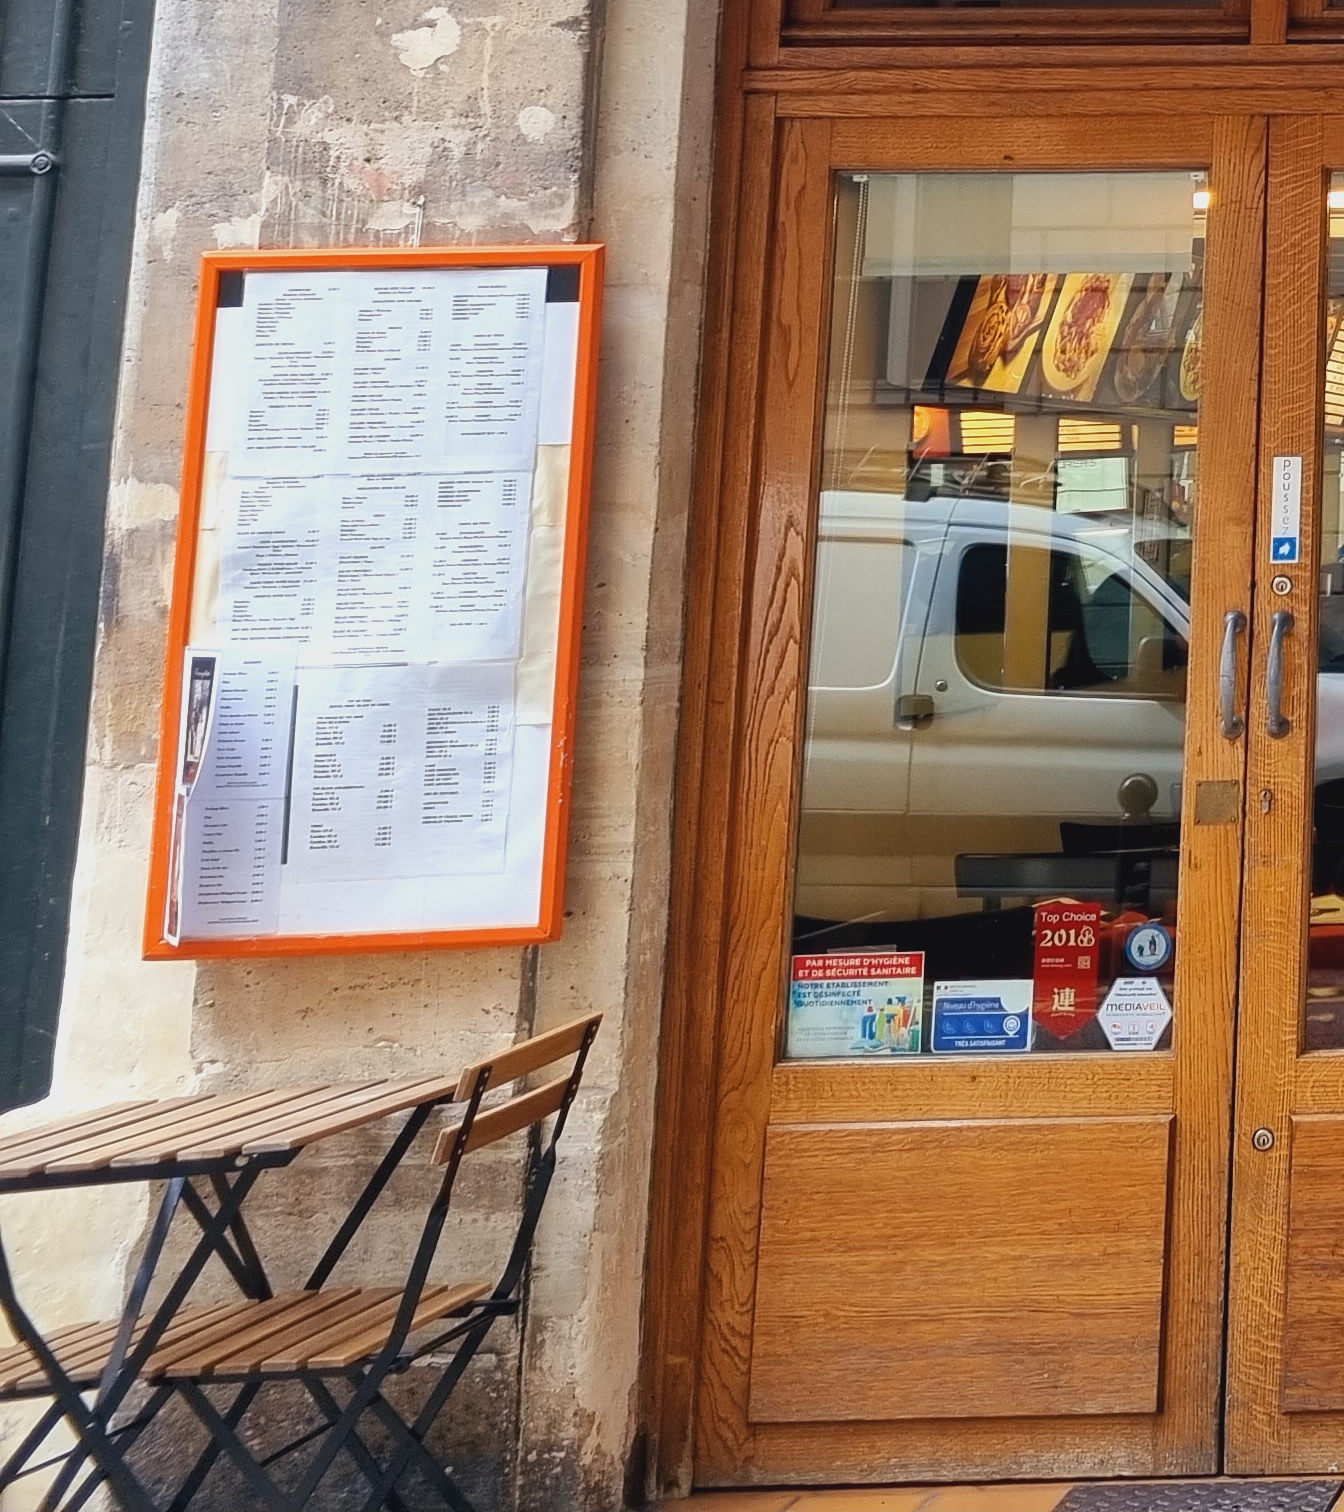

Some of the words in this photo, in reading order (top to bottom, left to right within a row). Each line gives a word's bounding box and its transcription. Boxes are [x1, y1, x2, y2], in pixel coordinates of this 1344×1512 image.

[1041, 912, 1060, 924] Top
[1062, 912, 1097, 922] Choice
[806, 959, 823, 967] PAR
[825, 958, 860, 966] MESURE
[863, 956, 910, 965] D'HYGIÈNE
[826, 967, 868, 976] SÉCURITÉ
[870, 967, 916, 975] SANITAIRE
[1106, 1002, 1165, 1012] MEDIAVEIL
